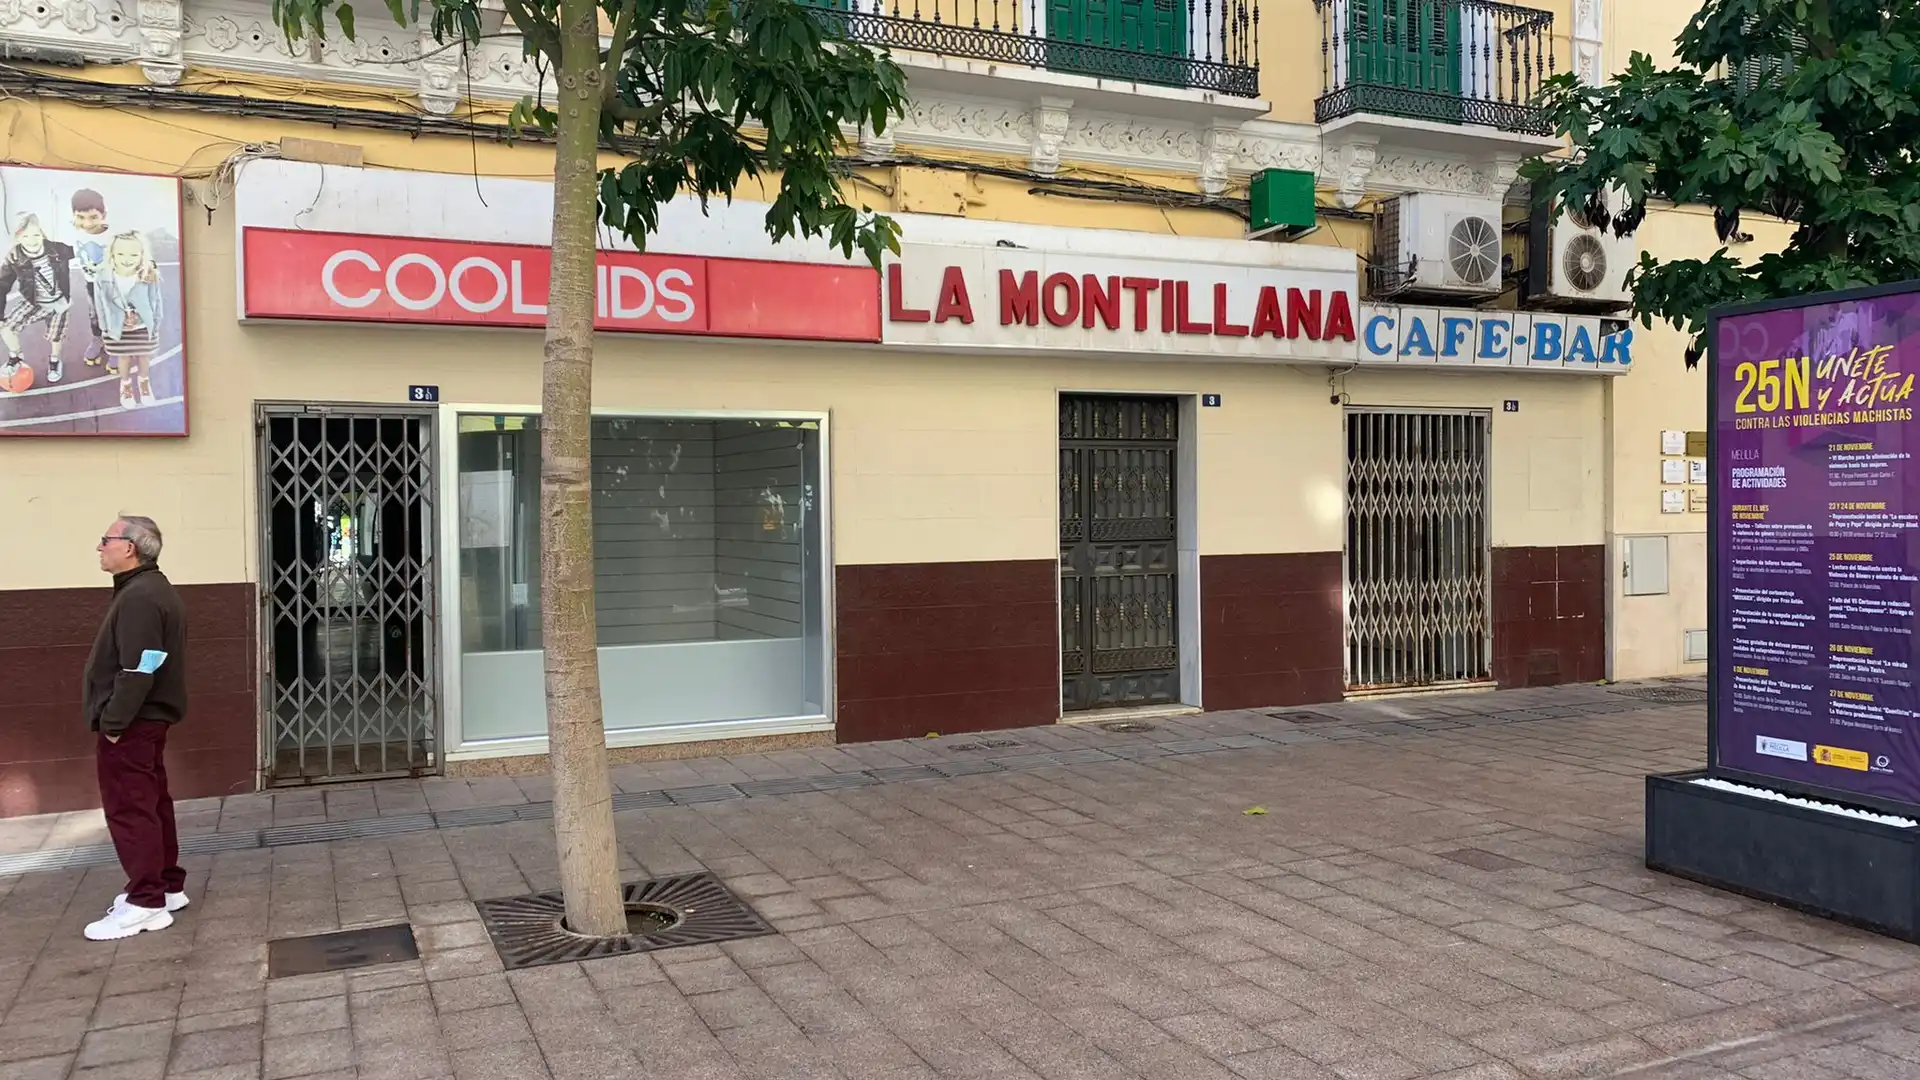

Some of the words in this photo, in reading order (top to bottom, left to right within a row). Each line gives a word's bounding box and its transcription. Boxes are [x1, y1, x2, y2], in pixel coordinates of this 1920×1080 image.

[321, 249, 695, 322] COOLIDS
[888, 263, 974, 323] LA
[999, 268, 1356, 342] MONTILLANA
[1735, 356, 1810, 413] 25N
[1838, 372, 1916, 409] ACTÚA
[1208, 395, 1216, 406] 3
[1735, 416, 1770, 430] CONTRA
[1773, 415, 1791, 428] LAS
[1793, 411, 1850, 427] VIOLENCIAS
[1853, 408, 1913, 424] MACHISTAS
[1732, 466, 1785, 478] PROGRAMACIÓN
[1742, 477, 1787, 488] ACTIVIDADES
